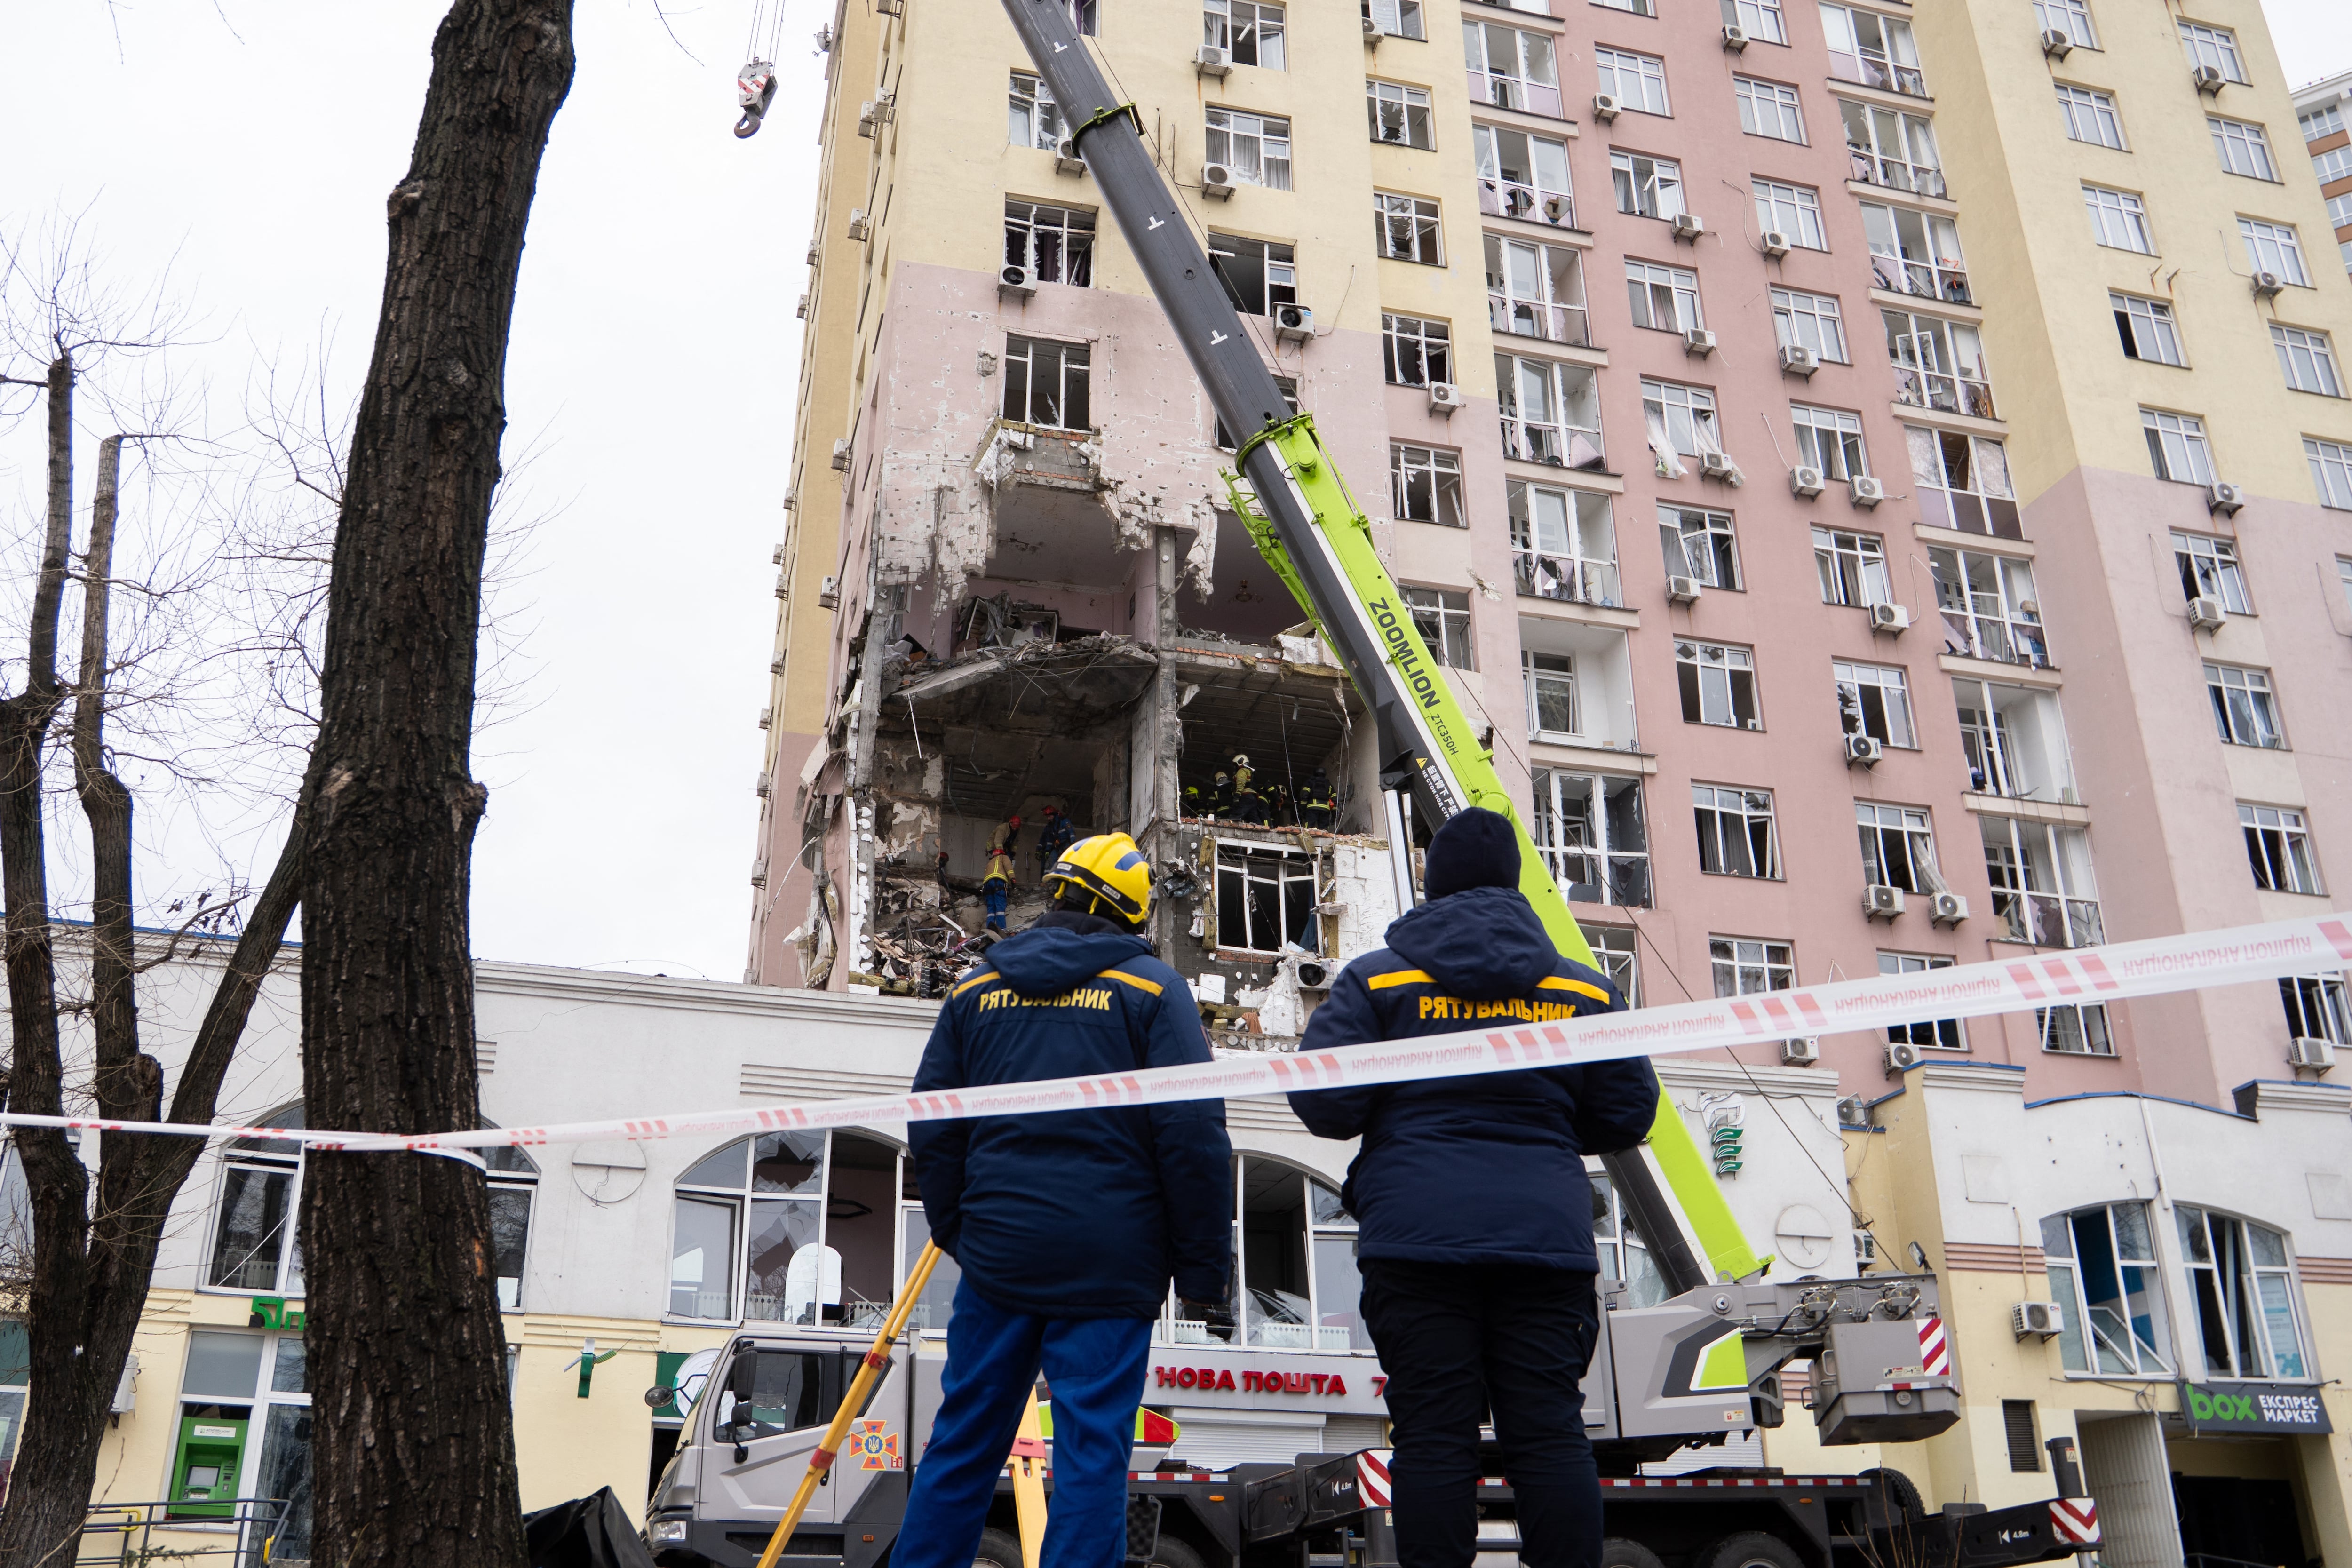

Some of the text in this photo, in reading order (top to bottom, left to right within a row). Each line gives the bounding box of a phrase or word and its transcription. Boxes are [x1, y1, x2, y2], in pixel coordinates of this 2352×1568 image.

[1369, 597, 1459, 756] ZOOMLION ZTC350H
[1422, 769, 1429, 779] НЕ
[1434, 795, 1444, 808] ПОД
[1427, 765, 1459, 817] 起重臂下 严禁
[1419, 996, 1576, 1023] РЯТУВАЛЬНИК
[1155, 1366, 1236, 1391] НОВА
[1242, 1369, 1347, 1394] ПОШТА
[2185, 1383, 2257, 1422] box
[2258, 1394, 2319, 1410] ЕКСПРЕС
[2263, 1409, 2318, 1424] МАРКЕТ
[2012, 1530, 2030, 1539] 4.8m
